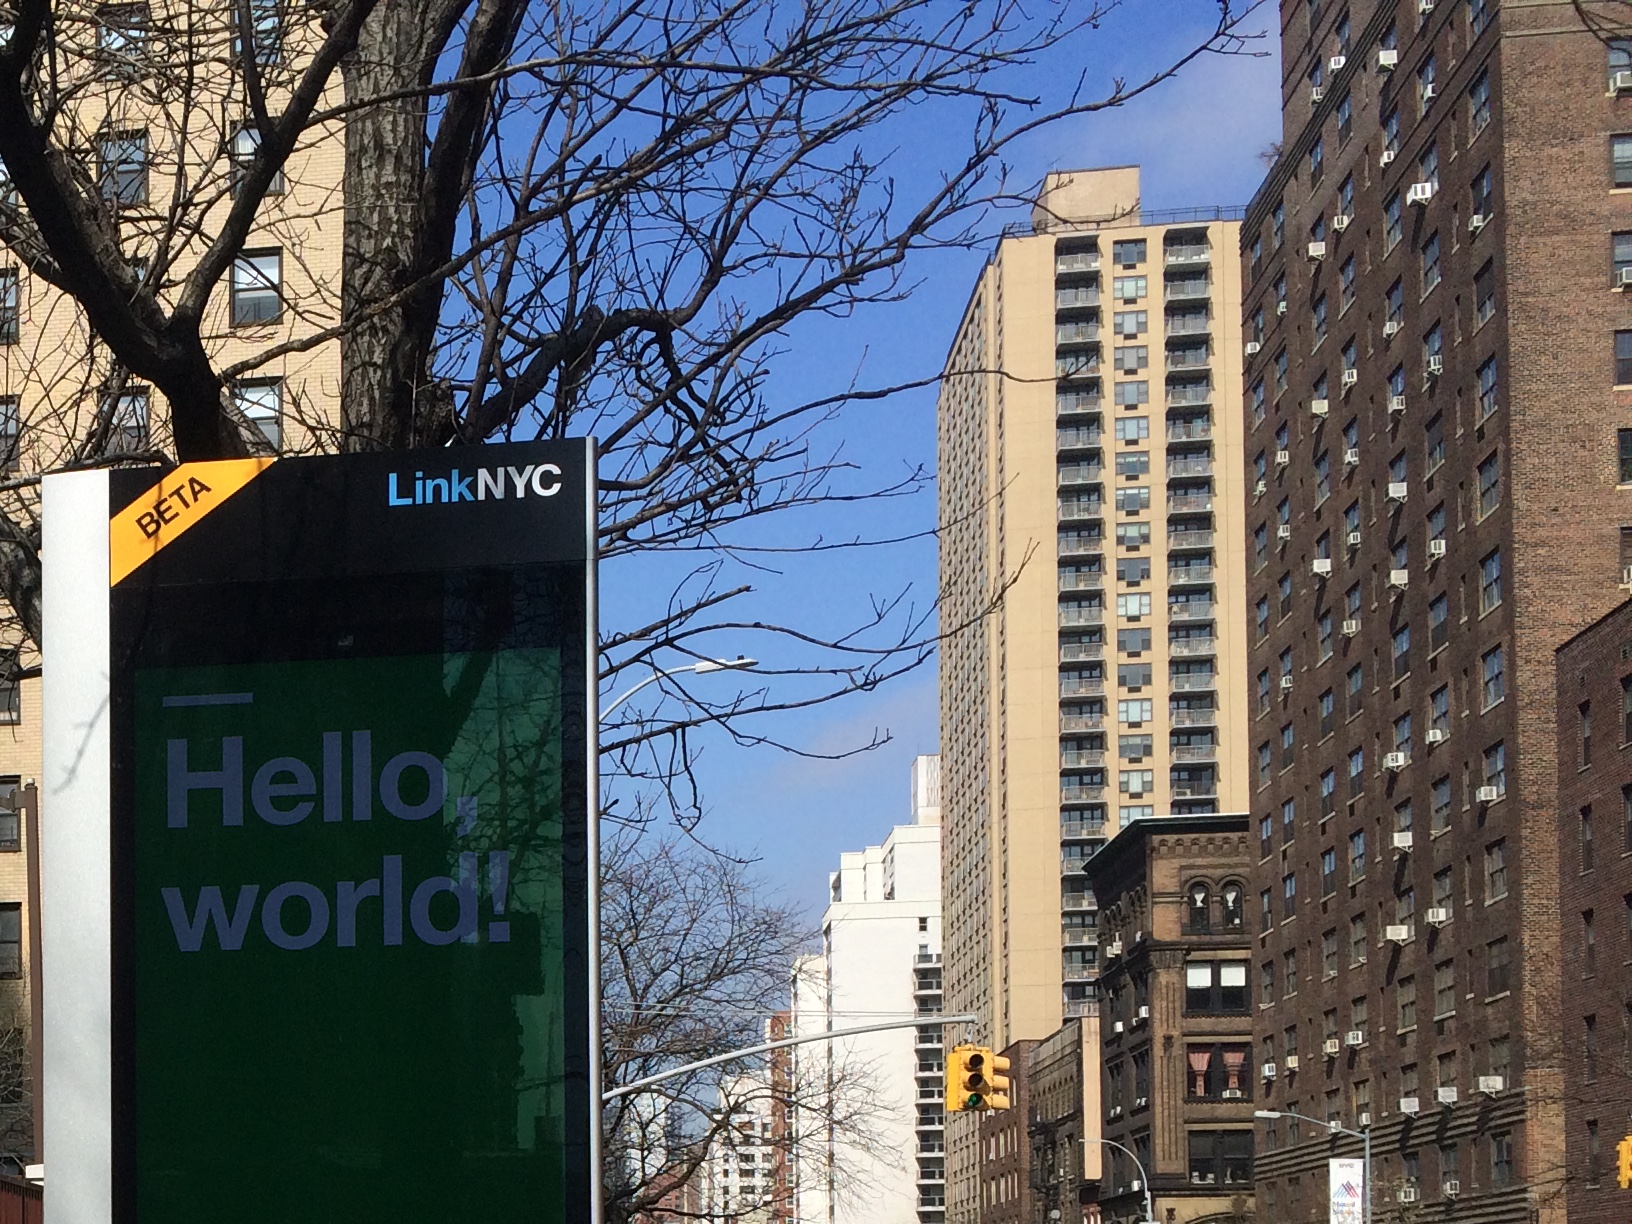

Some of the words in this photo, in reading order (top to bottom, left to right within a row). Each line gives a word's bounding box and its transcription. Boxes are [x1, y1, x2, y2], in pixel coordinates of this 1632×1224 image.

[135, 475, 212, 541] BETA
[388, 463, 562, 507] LinkNYC
[166, 729, 479, 837] Hello,
[160, 850, 511, 953] world!
